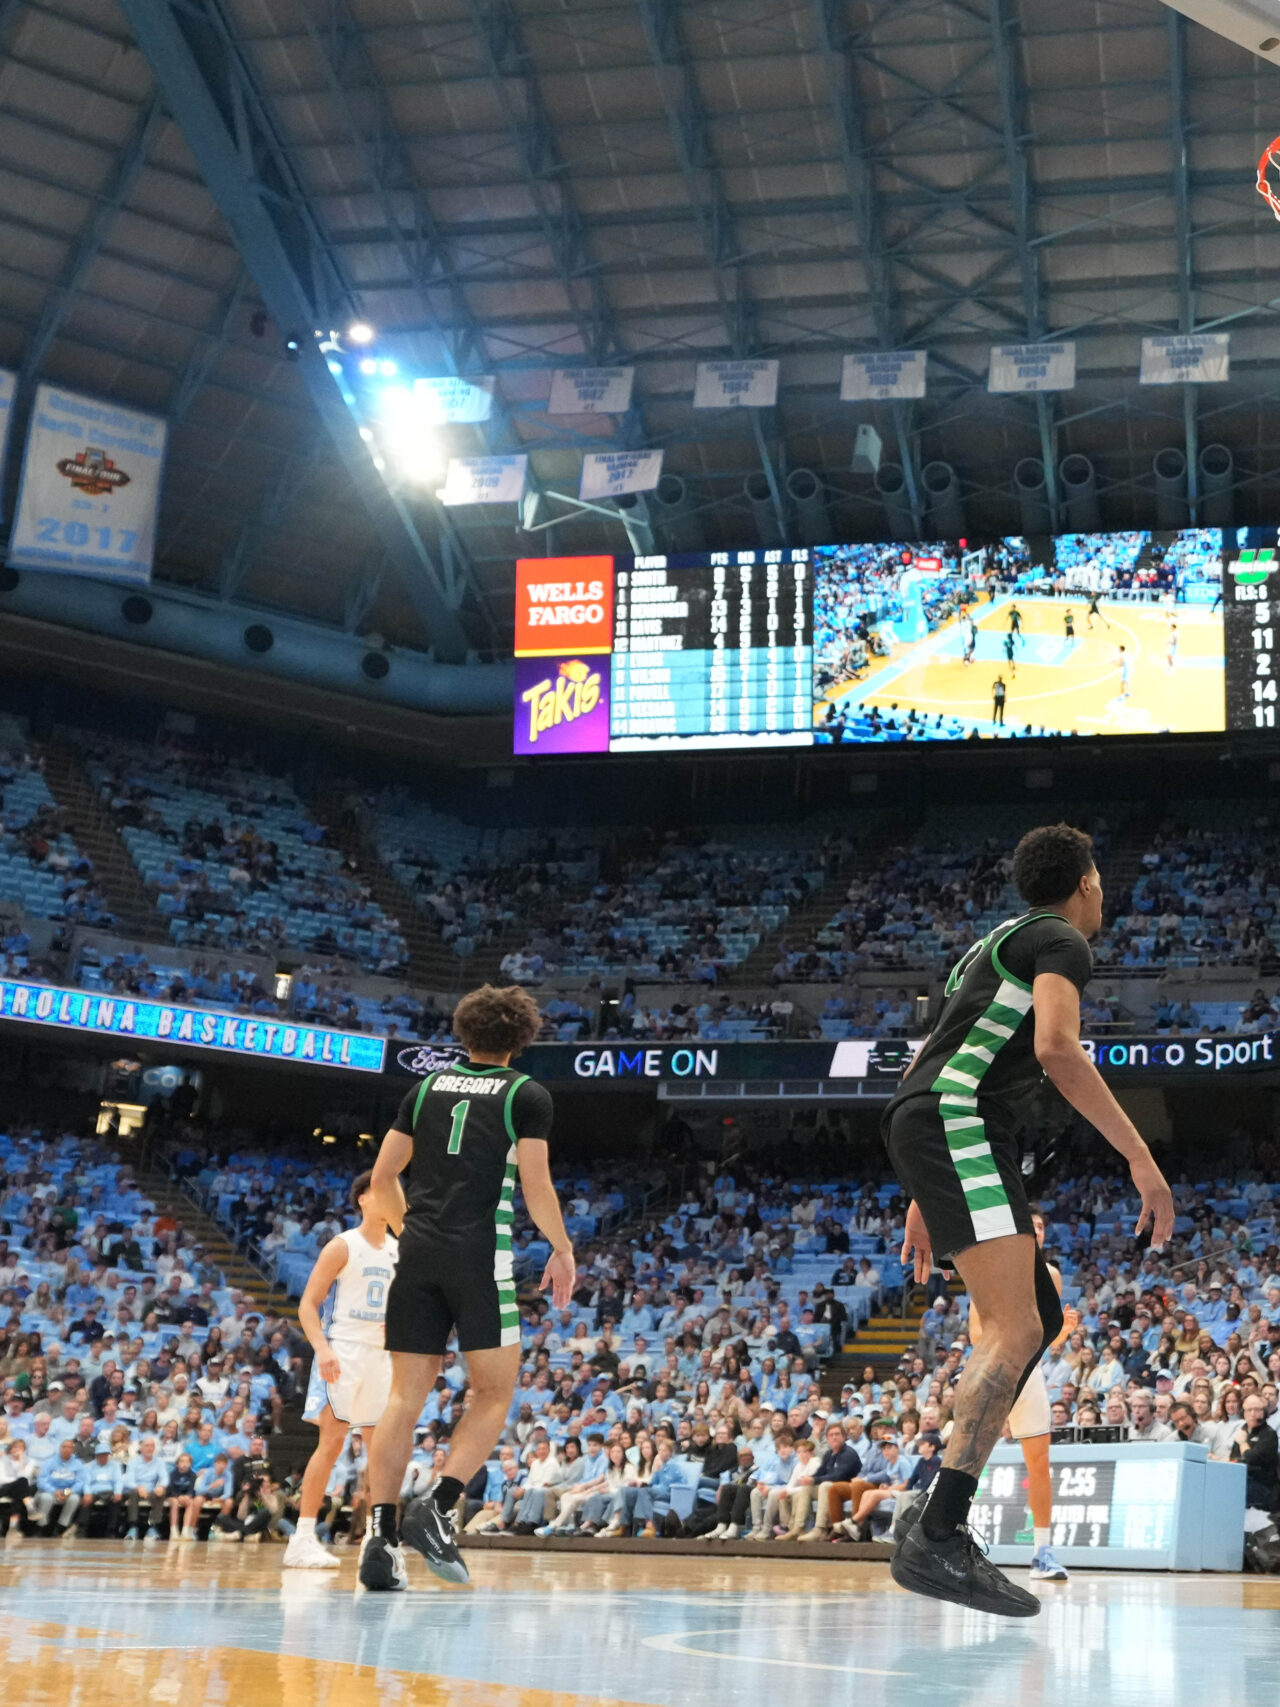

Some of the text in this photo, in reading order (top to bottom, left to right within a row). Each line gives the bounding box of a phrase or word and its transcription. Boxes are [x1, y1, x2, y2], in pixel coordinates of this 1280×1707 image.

[37, 516, 138, 553] 2017
[711, 553, 728, 565] PTS
[764, 551, 781, 562] AST
[740, 566, 751, 582] 5
[767, 565, 778, 581] 5
[794, 563, 805, 580] 0
[526, 581, 604, 603] WELLS
[619, 589, 625, 603] 1
[714, 583, 724, 600] 7
[742, 582, 749, 598] 1
[796, 580, 803, 596] 1
[528, 604, 604, 626] FARGO
[711, 599, 727, 617] 13
[740, 598, 751, 615] 3
[769, 598, 776, 614] 1
[796, 597, 803, 613] 1
[1255, 602, 1269, 623] 5
[630, 620, 662, 635] DAVIS
[711, 617, 727, 633] 14
[740, 615, 751, 632] 2
[767, 614, 778, 630] 0
[794, 613, 805, 629] 3
[714, 633, 724, 649] 4
[769, 631, 776, 647] 1
[796, 630, 803, 647] 1
[1252, 628, 1273, 649] 11
[740, 664, 751, 681] 7
[767, 663, 778, 680] 3
[796, 663, 803, 679] 1
[1256, 654, 1270, 674] 2
[742, 681, 749, 697] 1
[796, 679, 803, 695] 1
[1252, 680, 1277, 701] 14
[521, 671, 601, 742] Takis
[1254, 706, 1274, 726] 11
[0, 987, 352, 1065] ROLINA BASKETBALL
[1195, 1034, 1273, 1069] Sport
[574, 1050, 718, 1077] GAME ON
[432, 1075, 507, 1095] GREGORY
[447, 1100, 470, 1154] 1
[367, 1280, 384, 1308] 0
[1058, 1467, 1097, 1497] 2:55
[1089, 1524, 1101, 1547] 3
